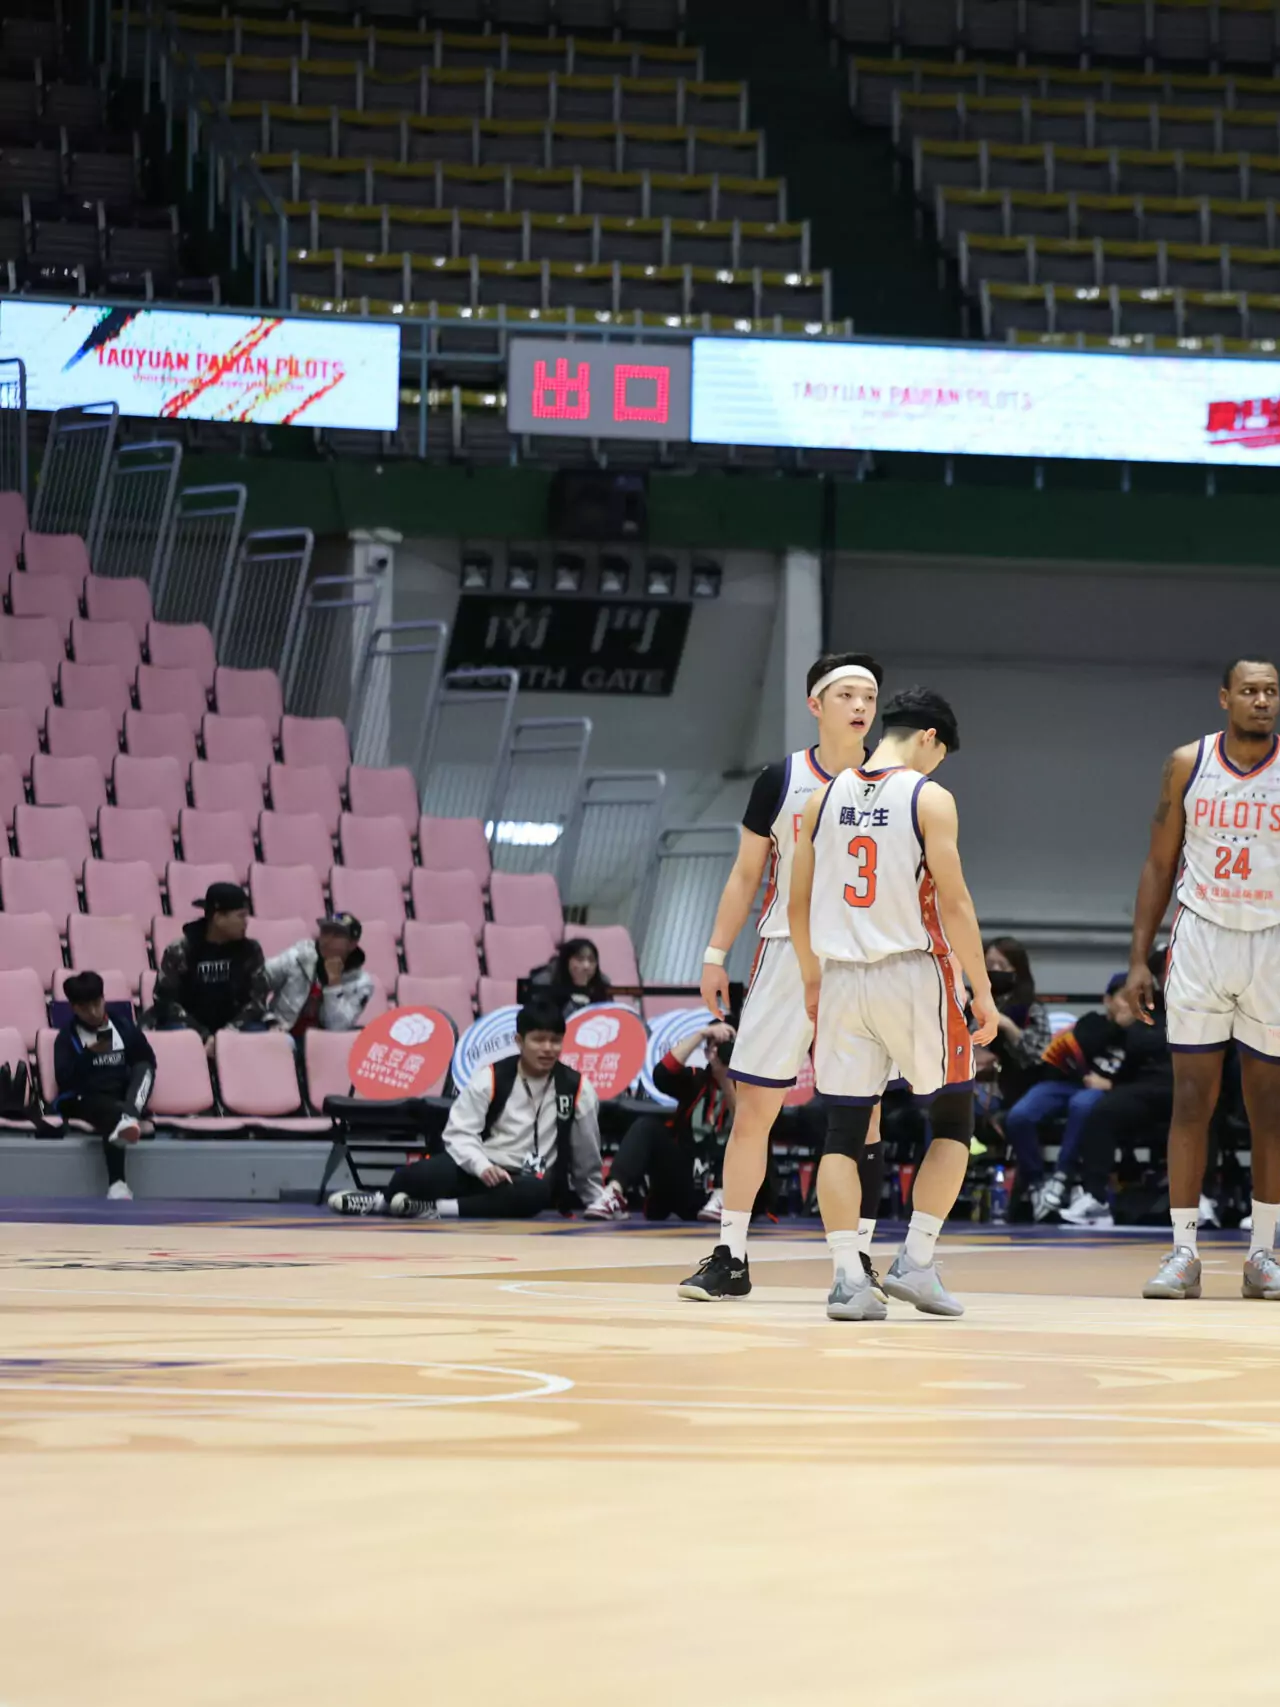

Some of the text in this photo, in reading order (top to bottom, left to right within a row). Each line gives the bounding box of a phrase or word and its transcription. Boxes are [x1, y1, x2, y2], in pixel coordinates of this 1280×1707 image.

[96, 346, 189, 371] TAOYUAN
[532, 358, 670, 424] 出口
[843, 835, 878, 908] 3
[1214, 846, 1252, 880] 24
